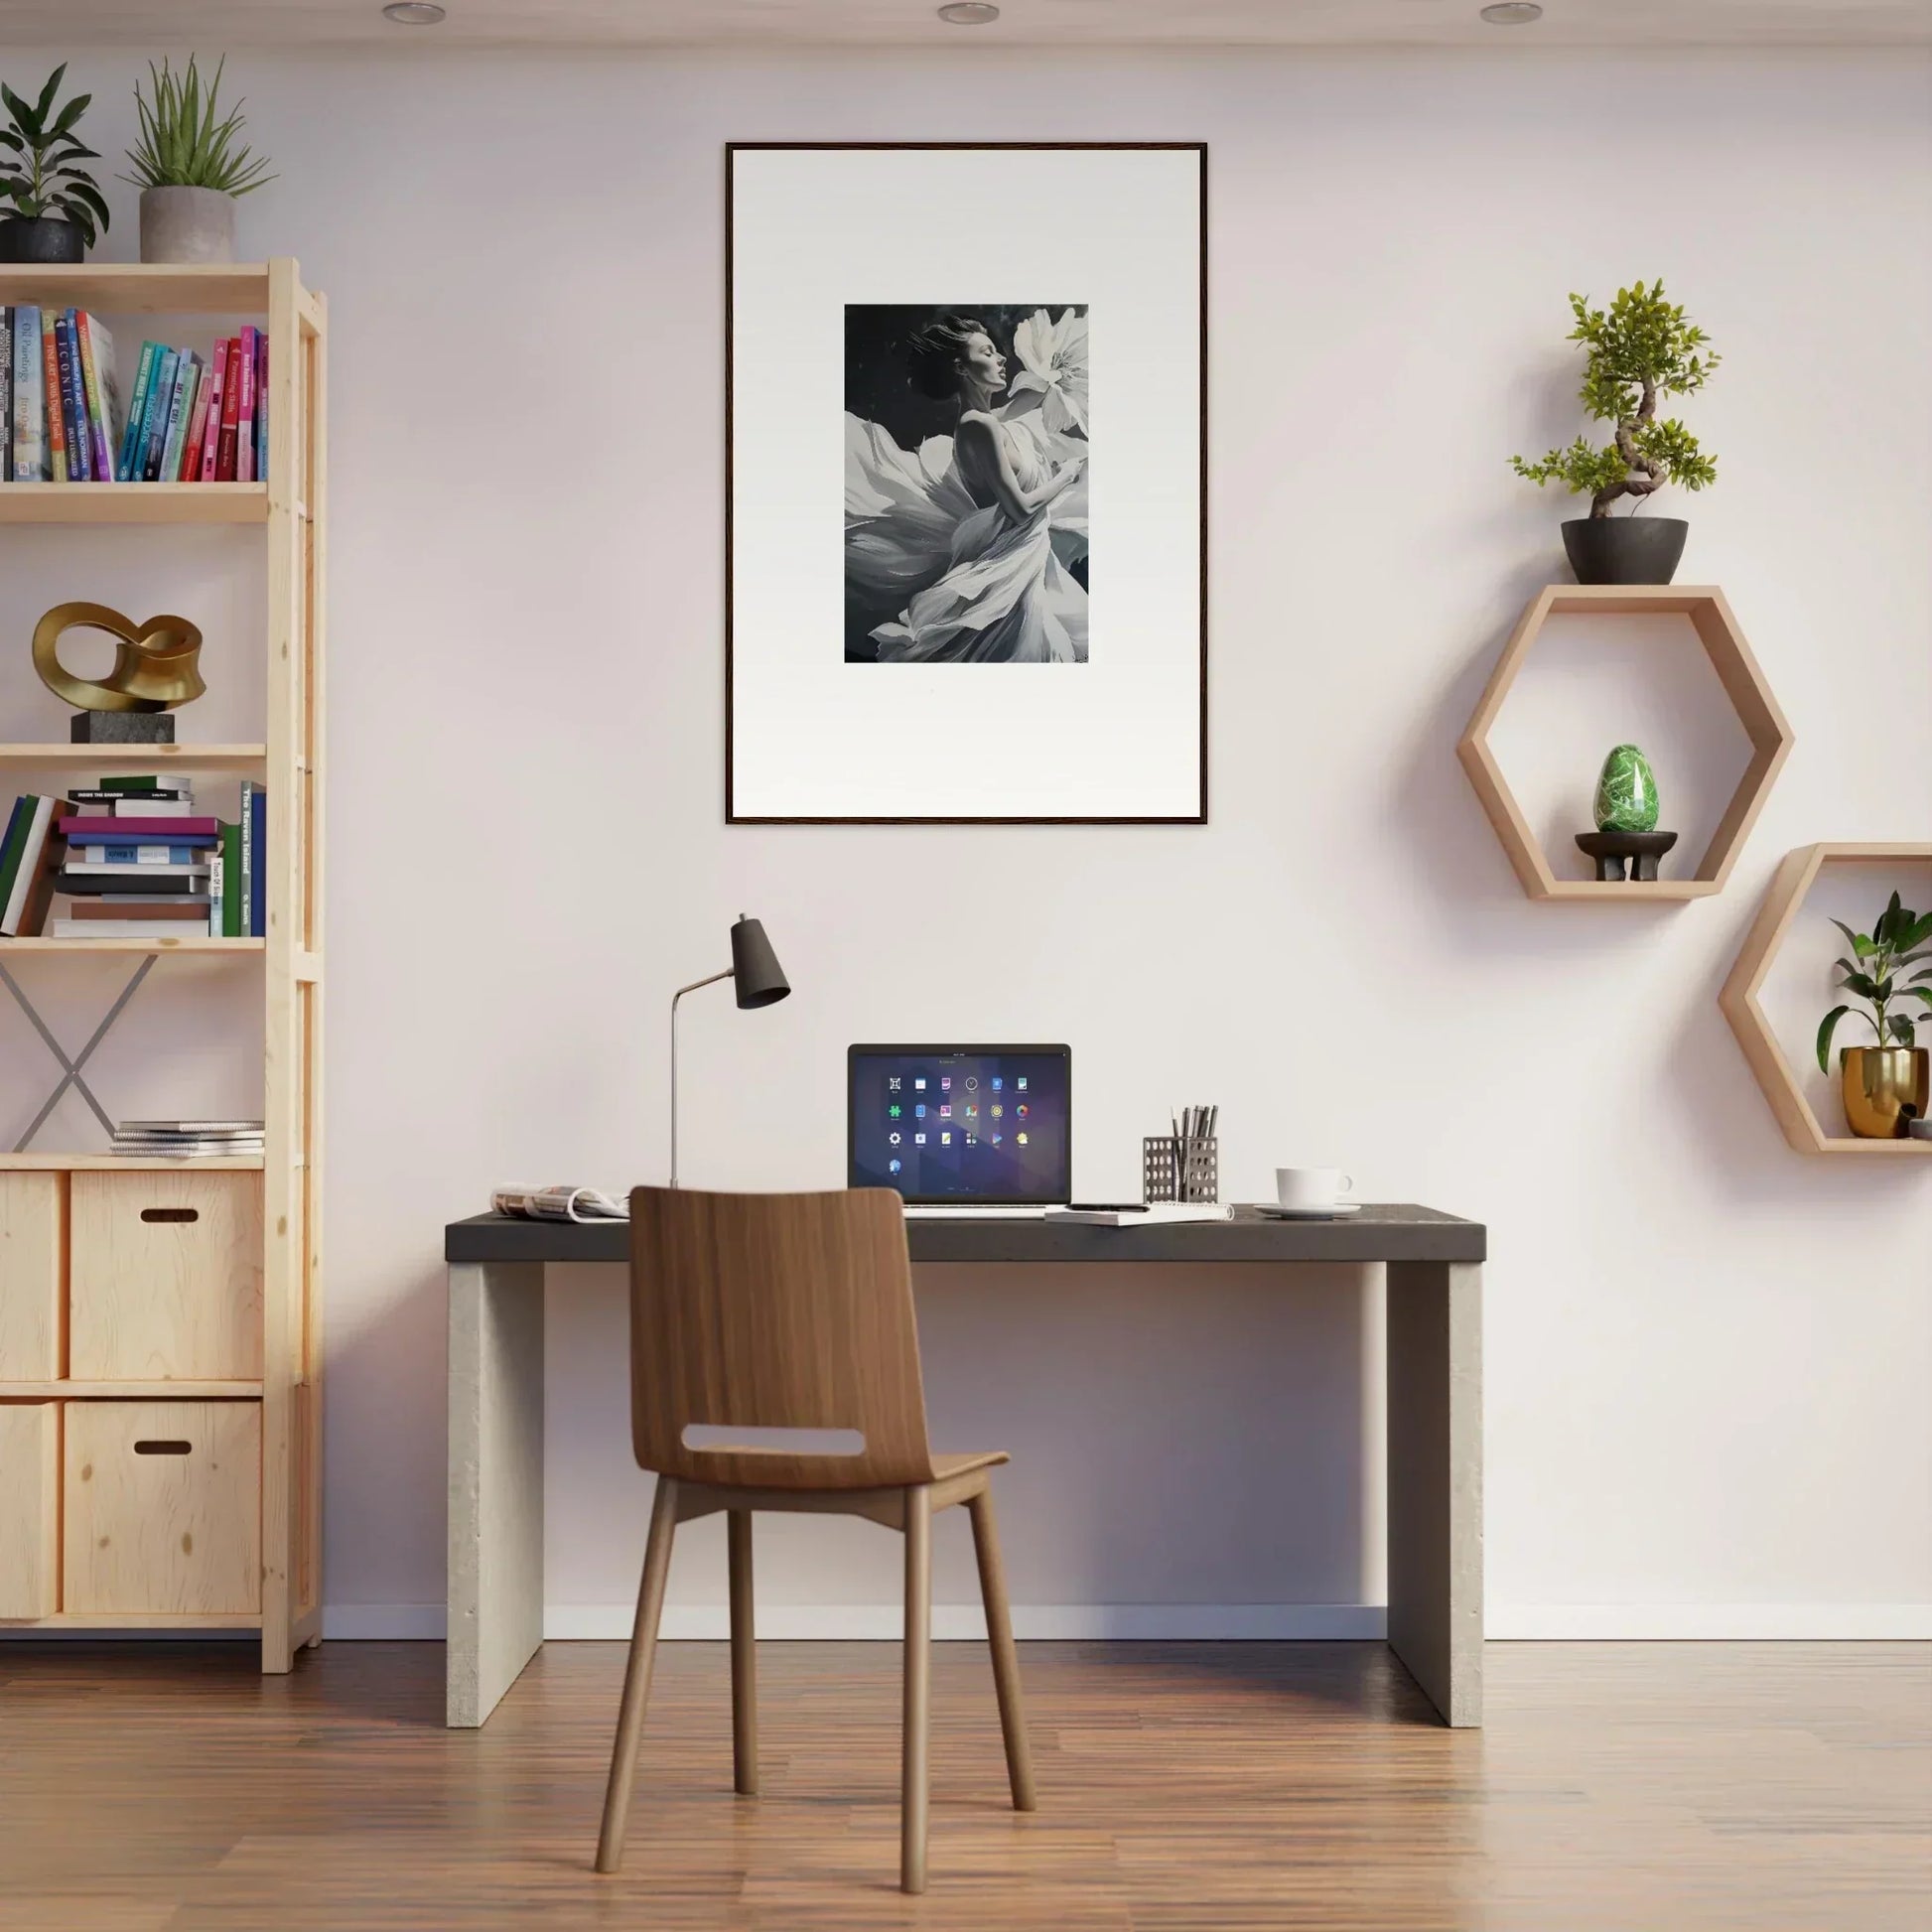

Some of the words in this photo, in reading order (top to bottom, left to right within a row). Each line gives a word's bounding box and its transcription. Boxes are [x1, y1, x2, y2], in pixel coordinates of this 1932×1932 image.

[22, 323, 32, 338] Oil
[19, 340, 32, 383] Paintings
[71, 356, 80, 381] Beauty
[86, 372, 97, 409] Portraits
[227, 360, 239, 394] Parenting
[50, 400, 59, 422] Digital
